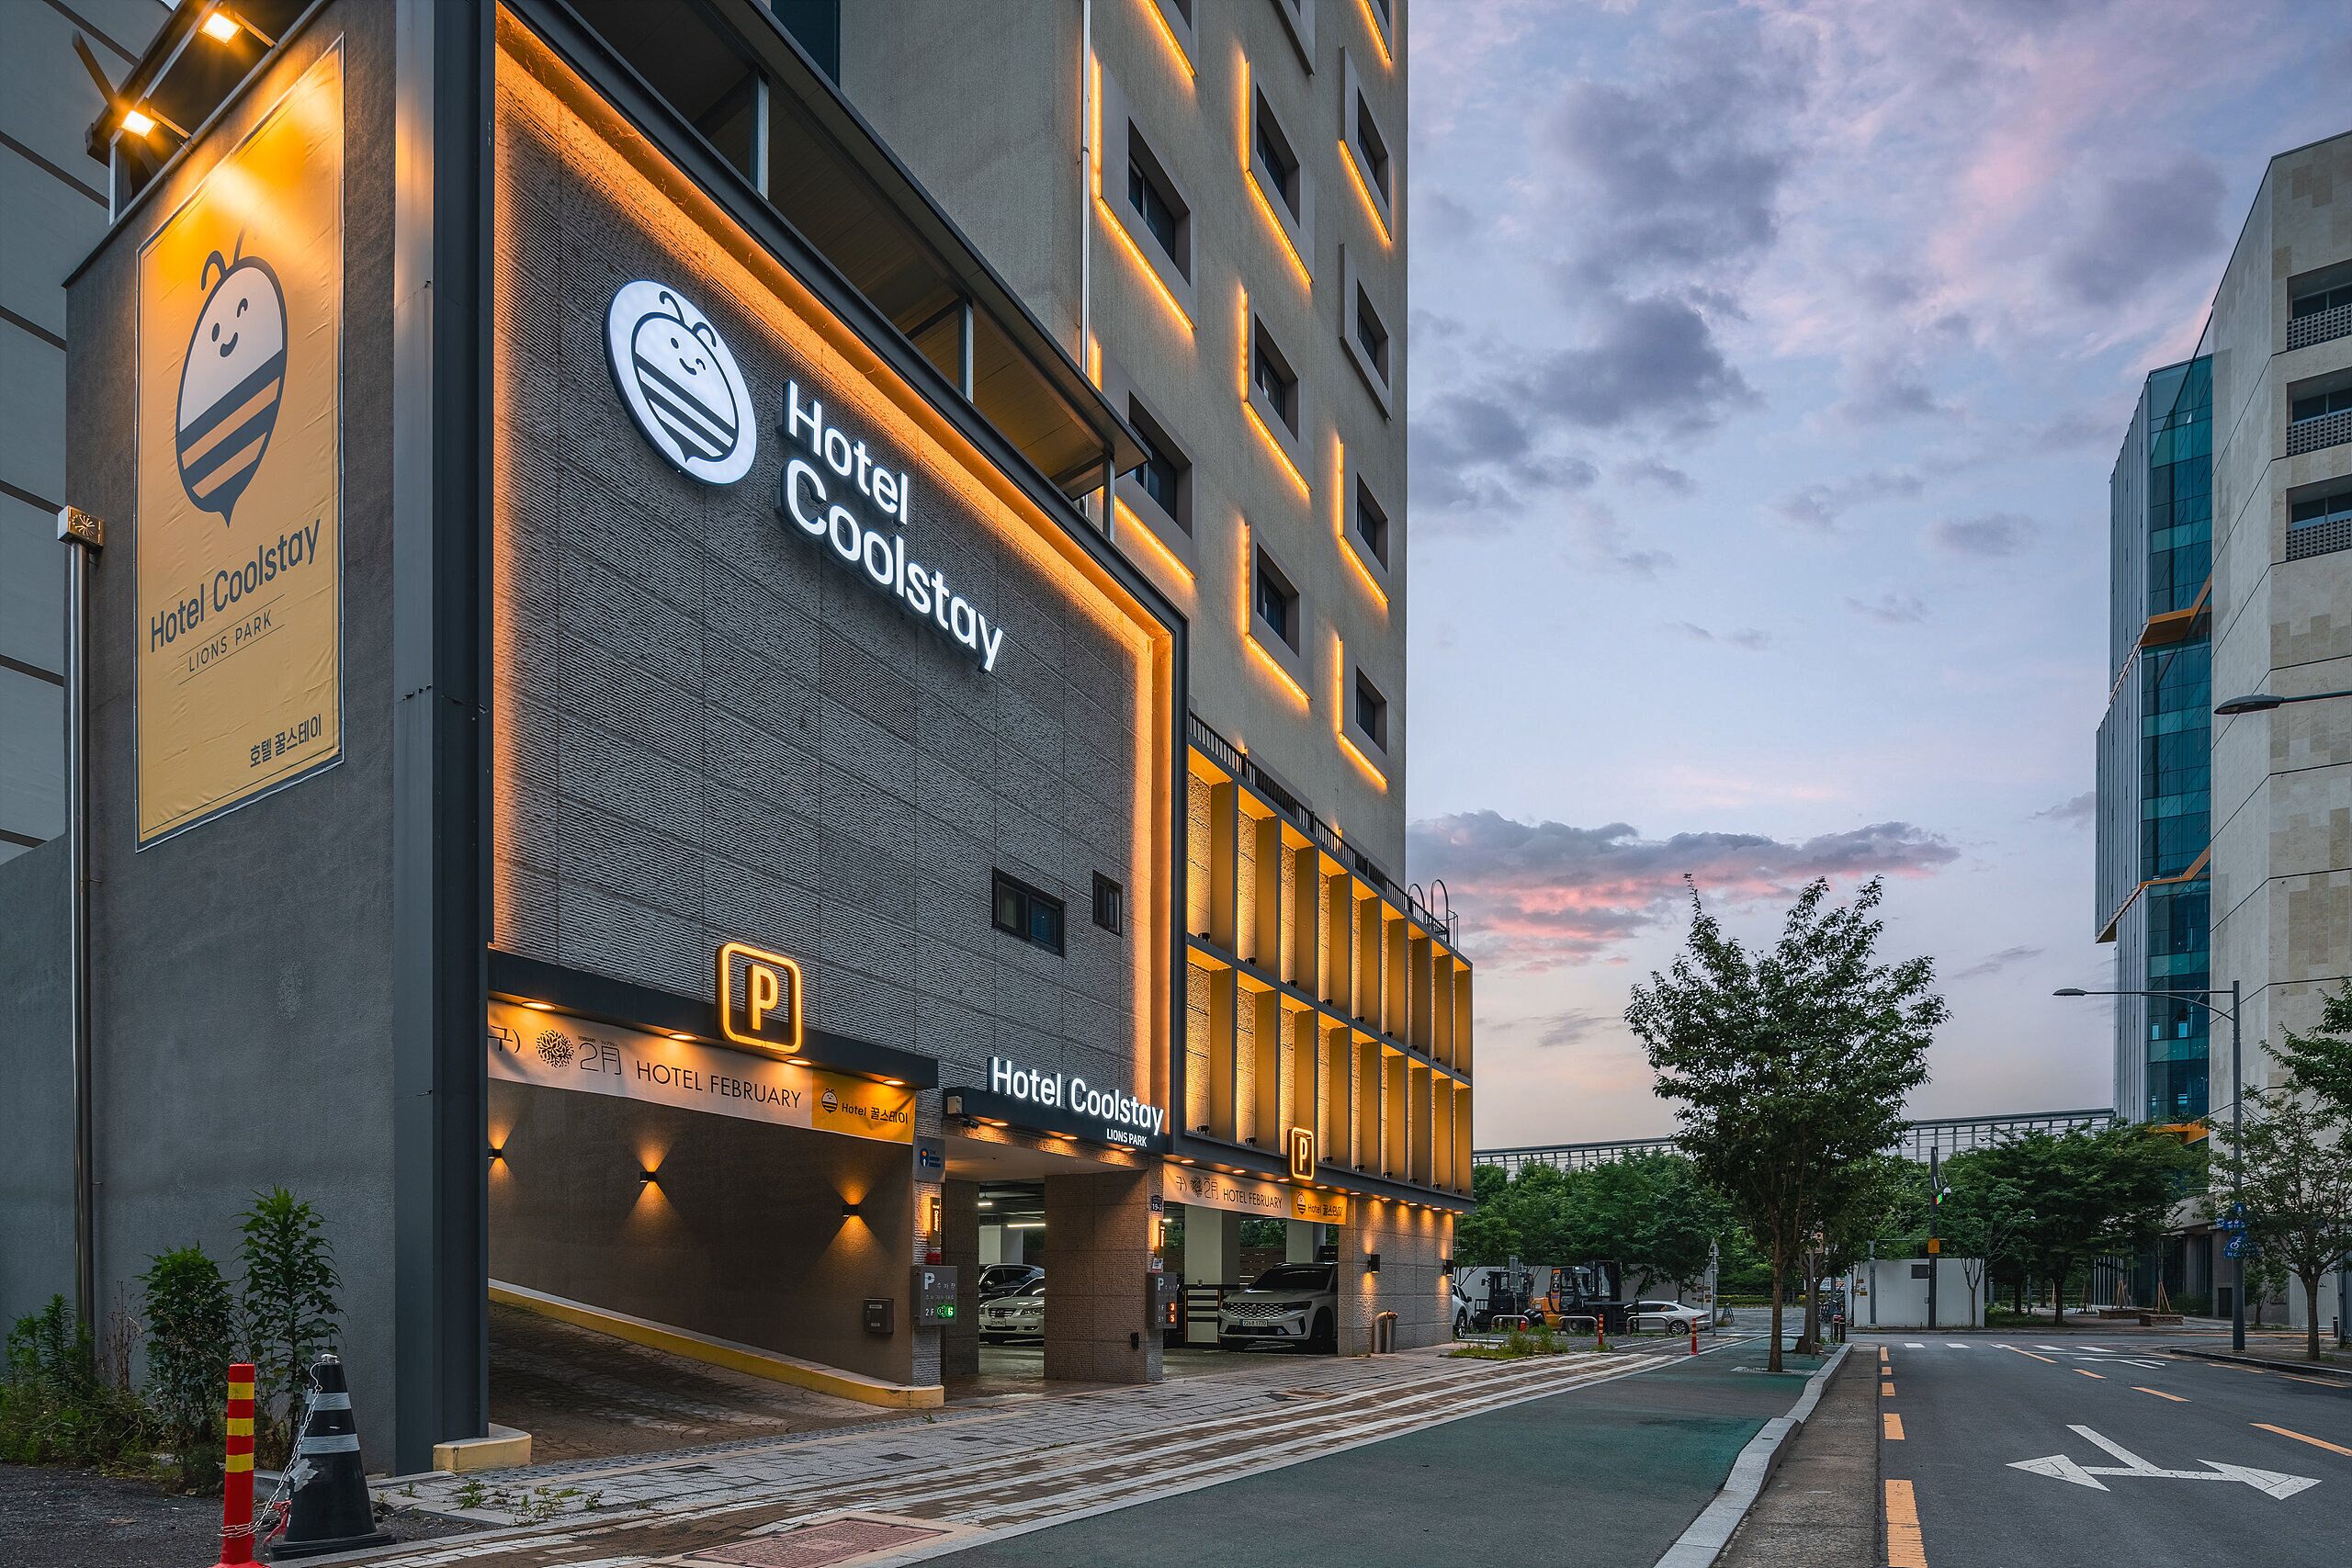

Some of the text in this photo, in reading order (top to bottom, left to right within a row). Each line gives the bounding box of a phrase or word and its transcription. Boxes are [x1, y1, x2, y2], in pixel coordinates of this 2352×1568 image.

[786, 379, 908, 525] Hotel
[151, 518, 321, 653] Hotel Coolstay
[786, 459, 1003, 671] Coolstay
[188, 609, 272, 672] LIONS PARK
[249, 713, 322, 769] 호텔 꿀스테이
[748, 964, 778, 1031] P
[636, 1060, 703, 1091] HOTEL
[710, 1075, 801, 1109] FEBRUARY
[991, 1056, 1164, 1136] Hotel Coolstay
[842, 1102, 908, 1124] Hotel 꿀스테이
[1106, 1128, 1148, 1147] LIONS PARK
[1299, 1136, 1308, 1171] P
[1223, 1188, 1248, 1204] HOTEL
[1249, 1192, 1283, 1209] FEBRUARY
[1307, 1203, 1321, 1214] Hotel
[924, 1272, 935, 1290] P
[1158, 1277, 1164, 1292] P
[925, 1308, 934, 1316] 2F
